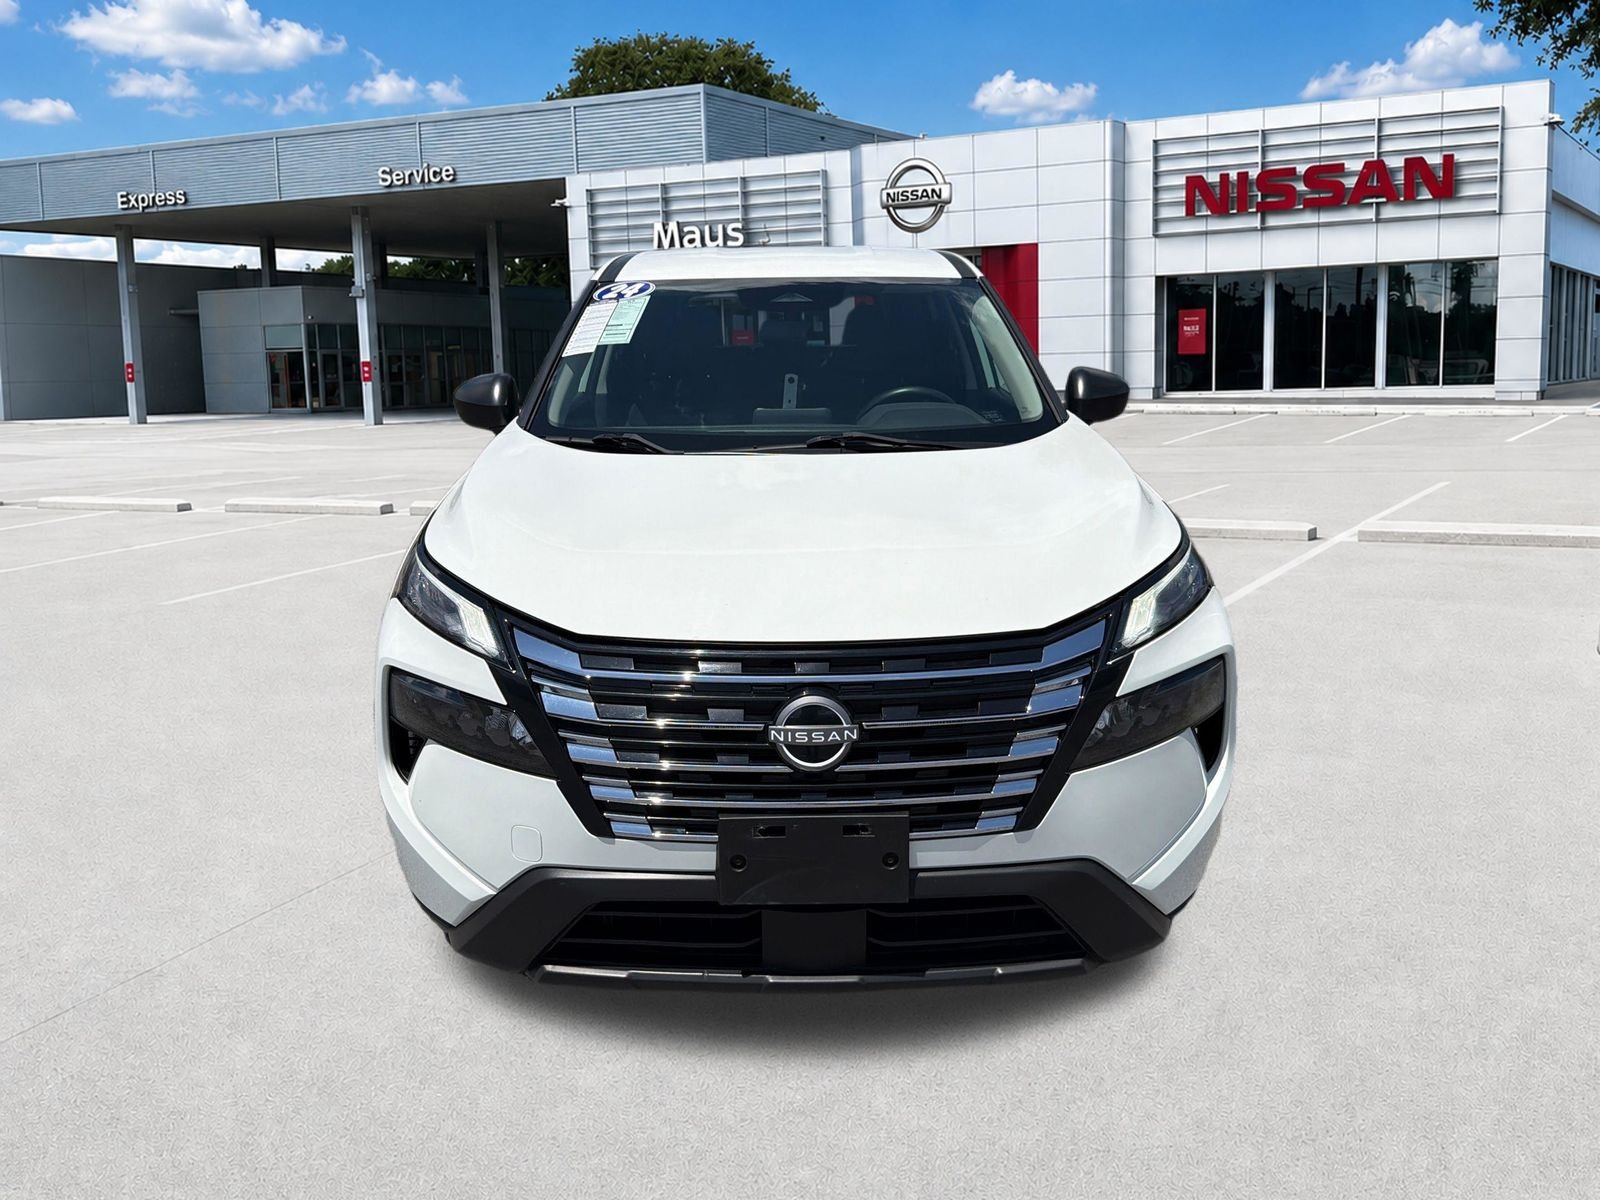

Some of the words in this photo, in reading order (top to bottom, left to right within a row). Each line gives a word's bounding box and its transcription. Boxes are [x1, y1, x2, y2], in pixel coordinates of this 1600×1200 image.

[378, 164, 455, 187] Service
[1185, 153, 1455, 216] NISSAN
[117, 191, 187, 211] Express
[886, 188, 942, 204] NISSAN
[652, 221, 744, 249] Maus
[602, 283, 647, 300] 24
[770, 728, 858, 743] NISSAN
